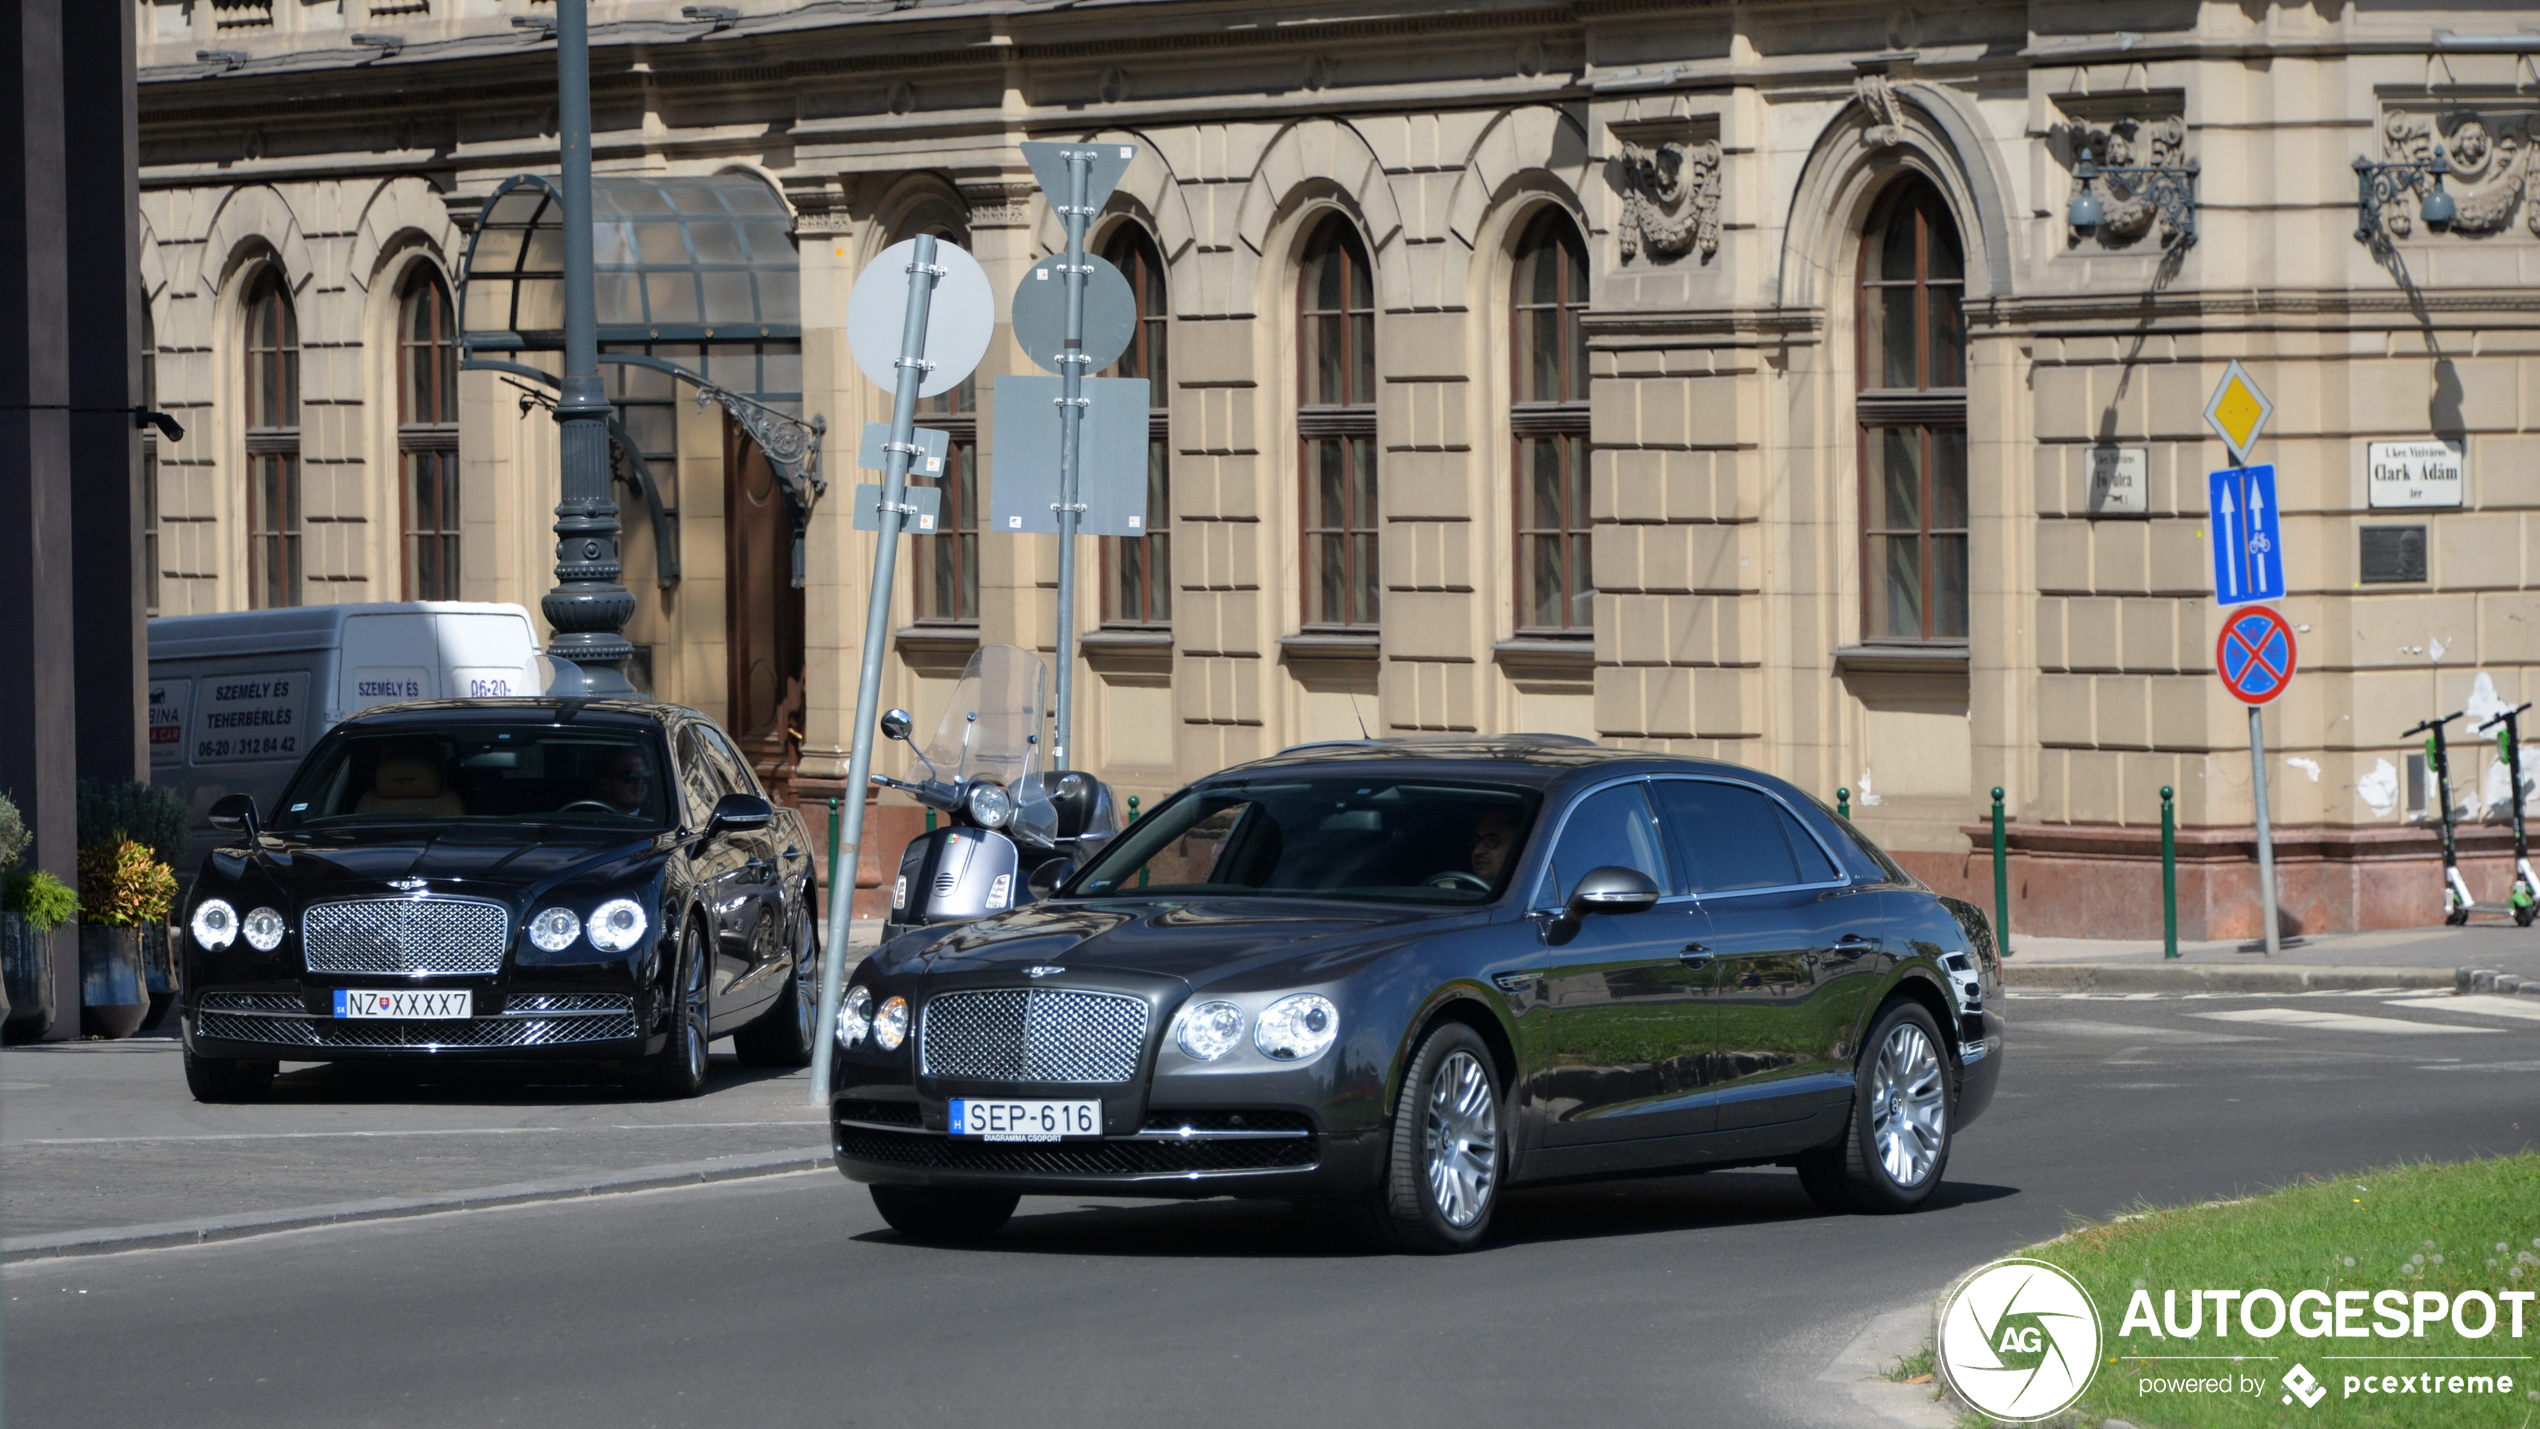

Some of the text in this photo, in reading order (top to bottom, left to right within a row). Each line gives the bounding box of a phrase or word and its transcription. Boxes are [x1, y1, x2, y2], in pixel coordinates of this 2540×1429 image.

[2375, 460, 2458, 481] Clark Ádám
[216, 679, 289, 700] SZEMÉLY ÉS
[358, 679, 418, 697] SZEMÉLY ÉS
[208, 706, 291, 728] TEHERBÉRLÉS
[161, 729, 178, 740] CAR
[198, 740, 229, 757] 06-20
[239, 738, 260, 754] 312
[263, 737, 277, 753] 84
[281, 736, 295, 752] 42
[350, 993, 467, 1015] NZ XXXX7
[954, 1120, 961, 1130] H
[971, 1104, 1092, 1131] SEP-616
[984, 1134, 1062, 1142] DIAGRAMMA CSOPORT
